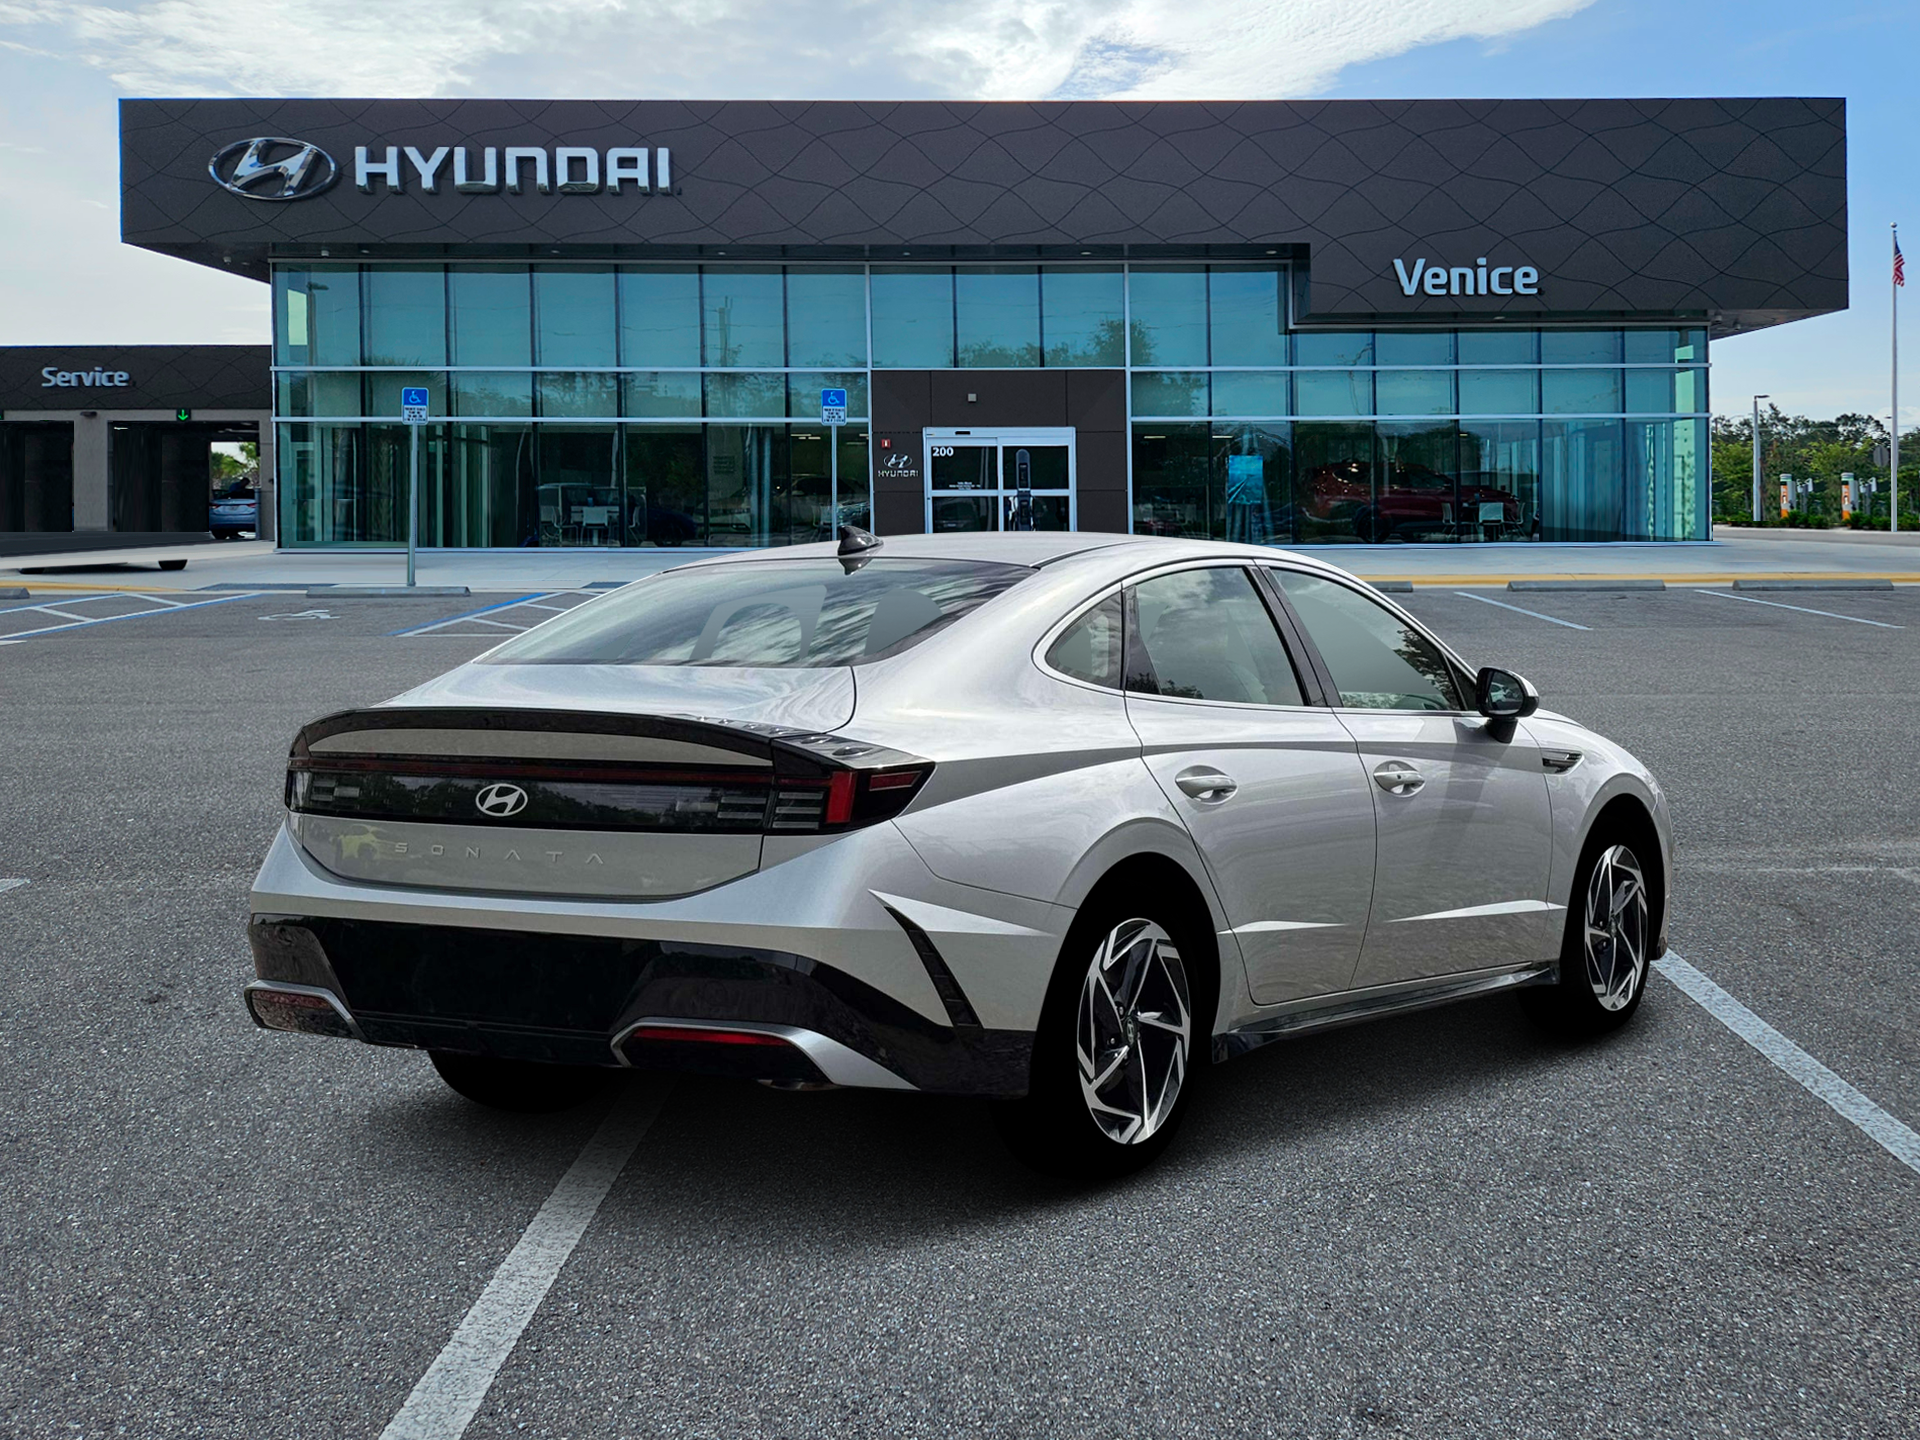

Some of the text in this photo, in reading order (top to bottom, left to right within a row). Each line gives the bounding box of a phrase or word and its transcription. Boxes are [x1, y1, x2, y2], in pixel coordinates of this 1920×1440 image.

[355, 146, 672, 194] HYUNDAI
[1392, 256, 1540, 296] Venice
[41, 366, 130, 387] Service
[932, 446, 954, 457] 200
[877, 469, 919, 478] HYUNDAI
[394, 842, 604, 866] SONATA
